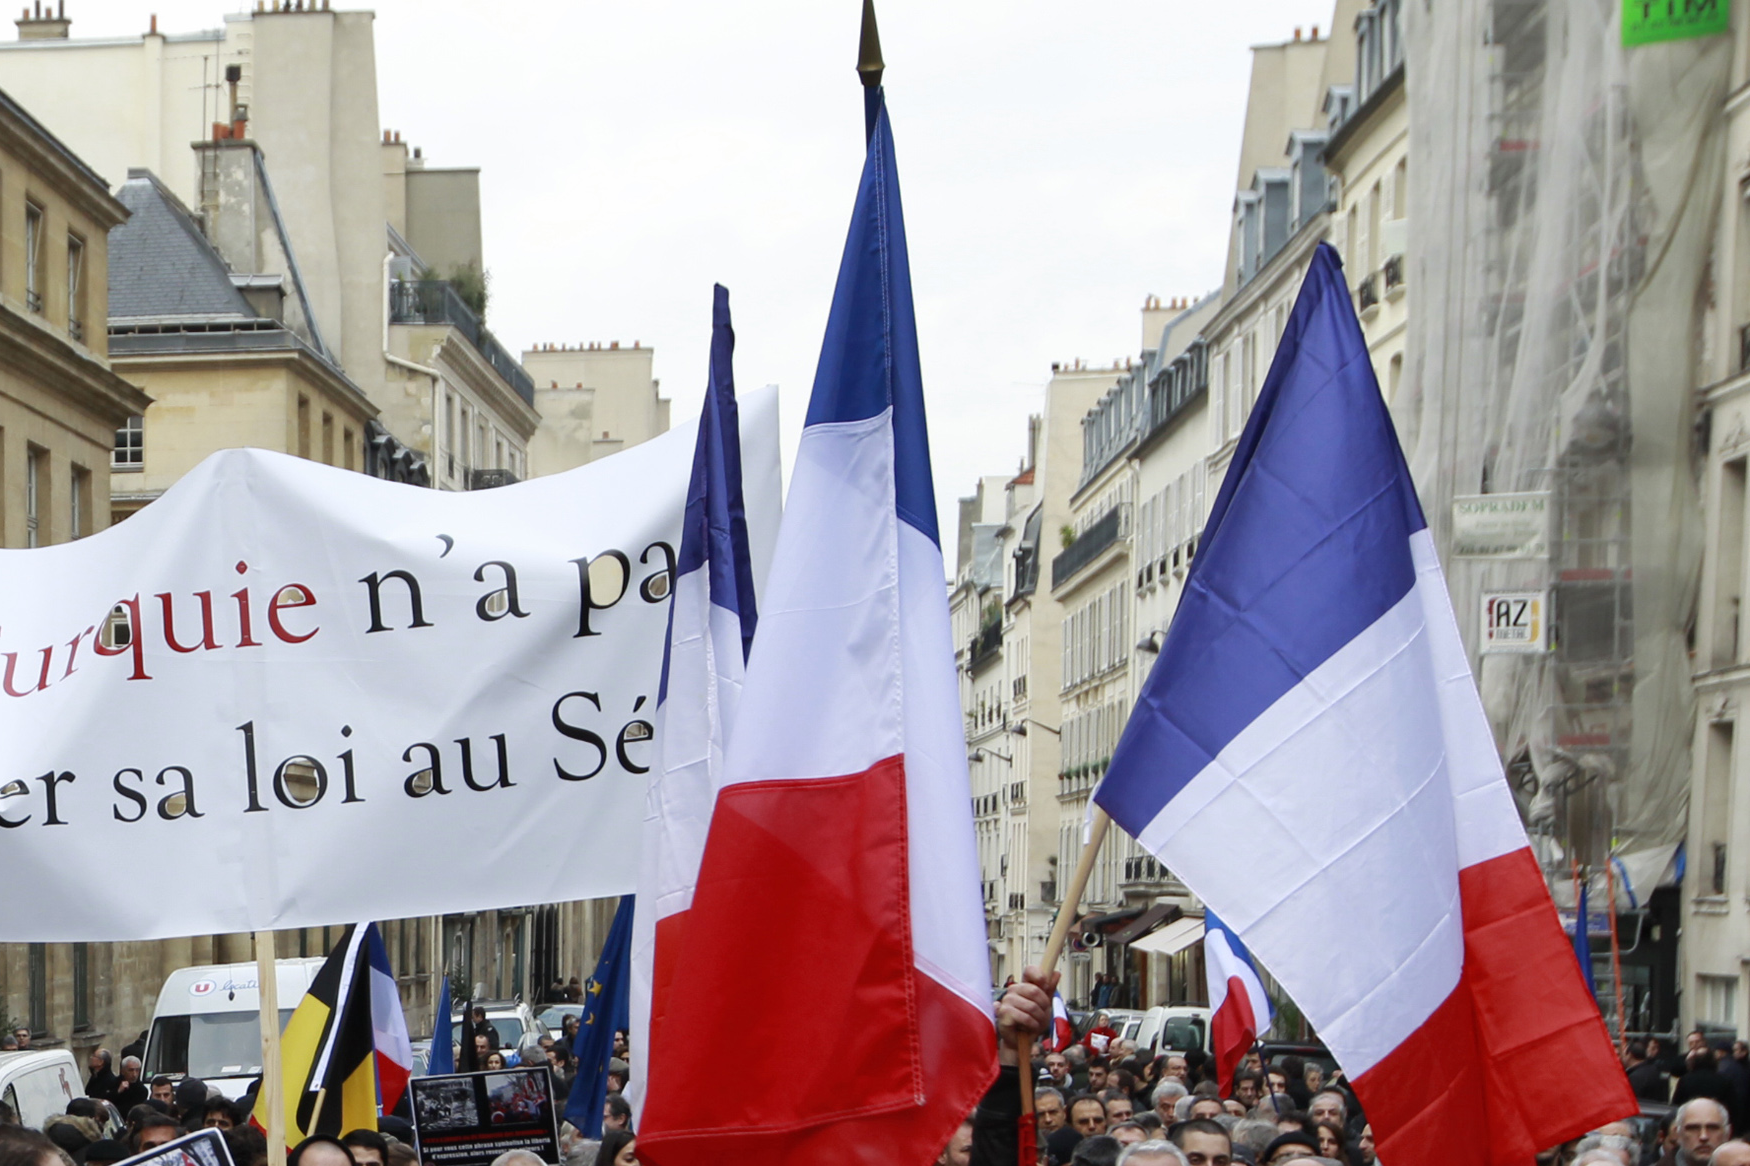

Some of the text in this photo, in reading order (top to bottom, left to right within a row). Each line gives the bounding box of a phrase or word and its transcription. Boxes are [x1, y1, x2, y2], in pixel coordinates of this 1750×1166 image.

[1496, 599, 1529, 627] AZ
[112, 766, 205, 823] sa
[236, 720, 366, 813] loi
[402, 733, 517, 799] au
[195, 983, 210, 993] U
[494, 1139, 523, 1147] symbolise
